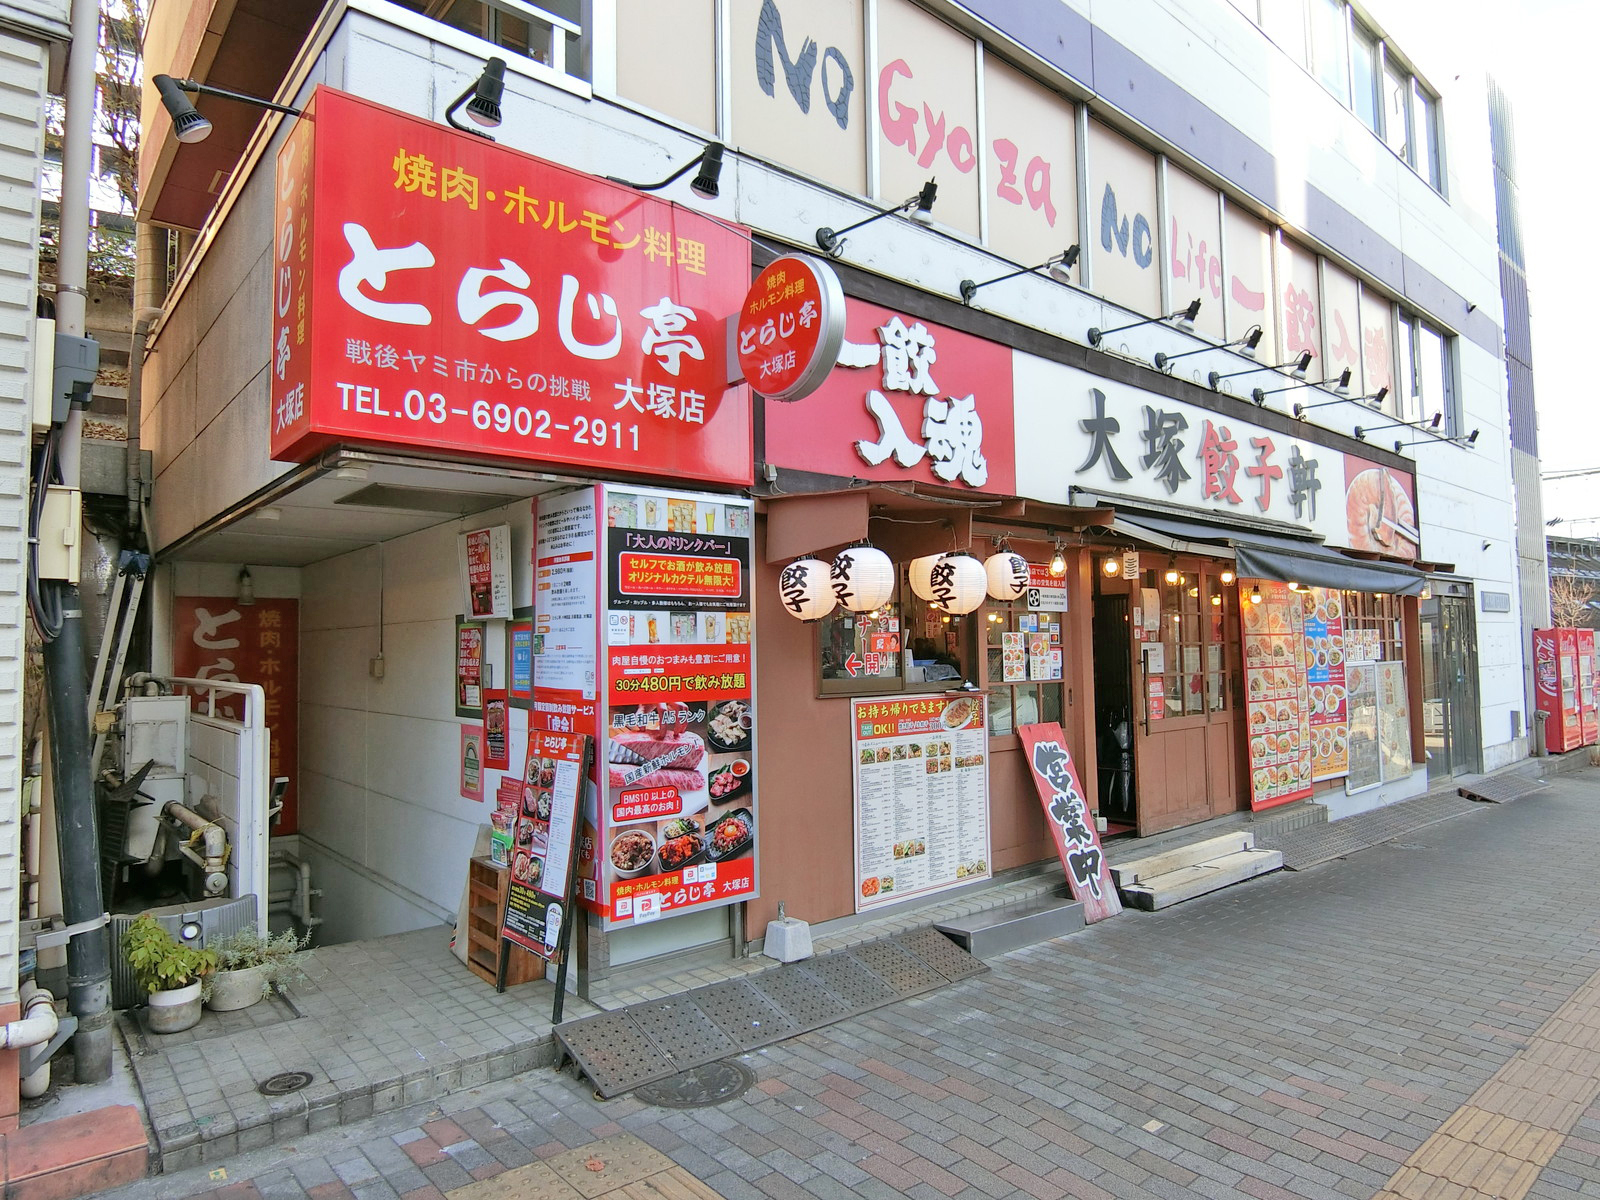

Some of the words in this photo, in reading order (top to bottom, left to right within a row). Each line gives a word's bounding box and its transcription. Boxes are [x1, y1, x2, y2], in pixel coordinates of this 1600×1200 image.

[879, 58, 1057, 228] Gyoza
[1172, 216, 1220, 299] Life
[392, 147, 708, 277] 焼肉・ホルモン料理
[277, 141, 296, 381] とらじ亭
[766, 271, 786, 292] 焼肉
[338, 222, 706, 377] とらじ亭
[750, 278, 805, 315] ホルモン料理
[740, 300, 818, 355] とらじ亭
[345, 338, 593, 403] 戦後ヤミ市からの挑戦
[759, 350, 796, 379] 大塚店
[276, 382, 305, 435] 大塚店
[336, 382, 641, 452] TEL.03-6902-2911
[614, 377, 707, 425] 大塚店
[853, 388, 989, 488] 入魂
[1075, 387, 1323, 522] 大塚餃子軒
[626, 533, 732, 555] 「大人のドリンクバー」
[630, 557, 734, 575] セルフでお酒が飲み放題
[831, 554, 854, 607] 餃子
[930, 563, 957, 610] 餃子
[1008, 556, 1029, 594] 餃子
[781, 564, 810, 613] 餃子
[193, 607, 242, 721] とら
[615, 673, 747, 692] 30分480円で飲み放題
[865, 652, 880, 675] 開
[613, 710, 660, 728] 黒毛和牛
[662, 711, 676, 725] A5
[678, 708, 706, 724] ランク
[873, 723, 895, 735] OK!!
[970, 698, 980, 726] 餃子
[544, 735, 567, 750] とらじ亭
[623, 793, 649, 805] BMS10
[651, 790, 675, 802] 以上の
[1033, 741, 1103, 900] 営業中
[616, 876, 679, 896] 焼肉・ホルモン料理
[660, 882, 716, 908] とらじ亭
[722, 877, 750, 893] 大塚店
[639, 911, 656, 919] PayPay
